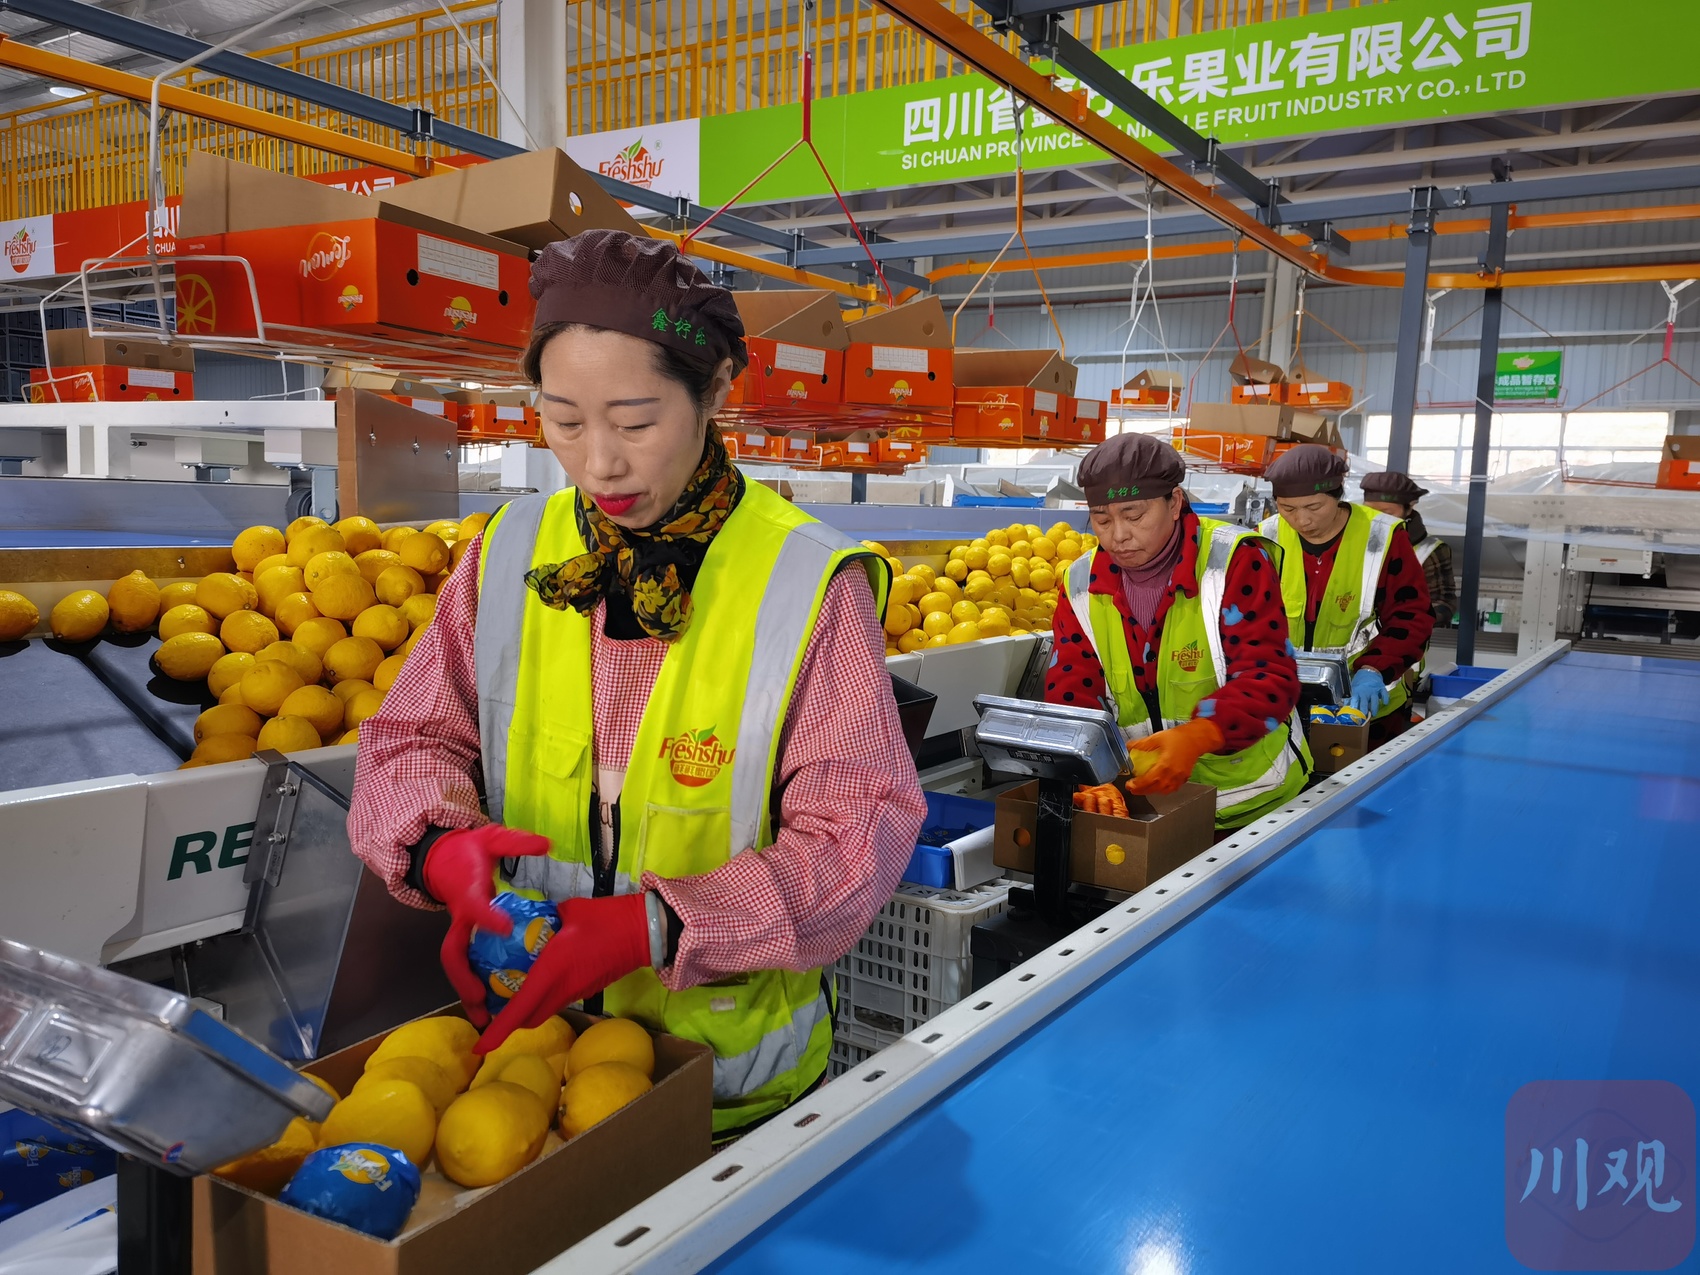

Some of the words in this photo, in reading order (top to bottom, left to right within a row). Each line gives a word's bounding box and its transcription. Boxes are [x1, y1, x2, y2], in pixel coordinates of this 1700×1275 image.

[901, 153, 917, 170] SI
[920, 145, 982, 168] CHUAN
[985, 131, 1084, 160] PROVINCE
[1214, 101, 1282, 128] FRUIT
[1286, 82, 1413, 118] INDUSTRY
[1495, 374, 1557, 386] 成品暂存区
[658, 735, 736, 766] Freshshu
